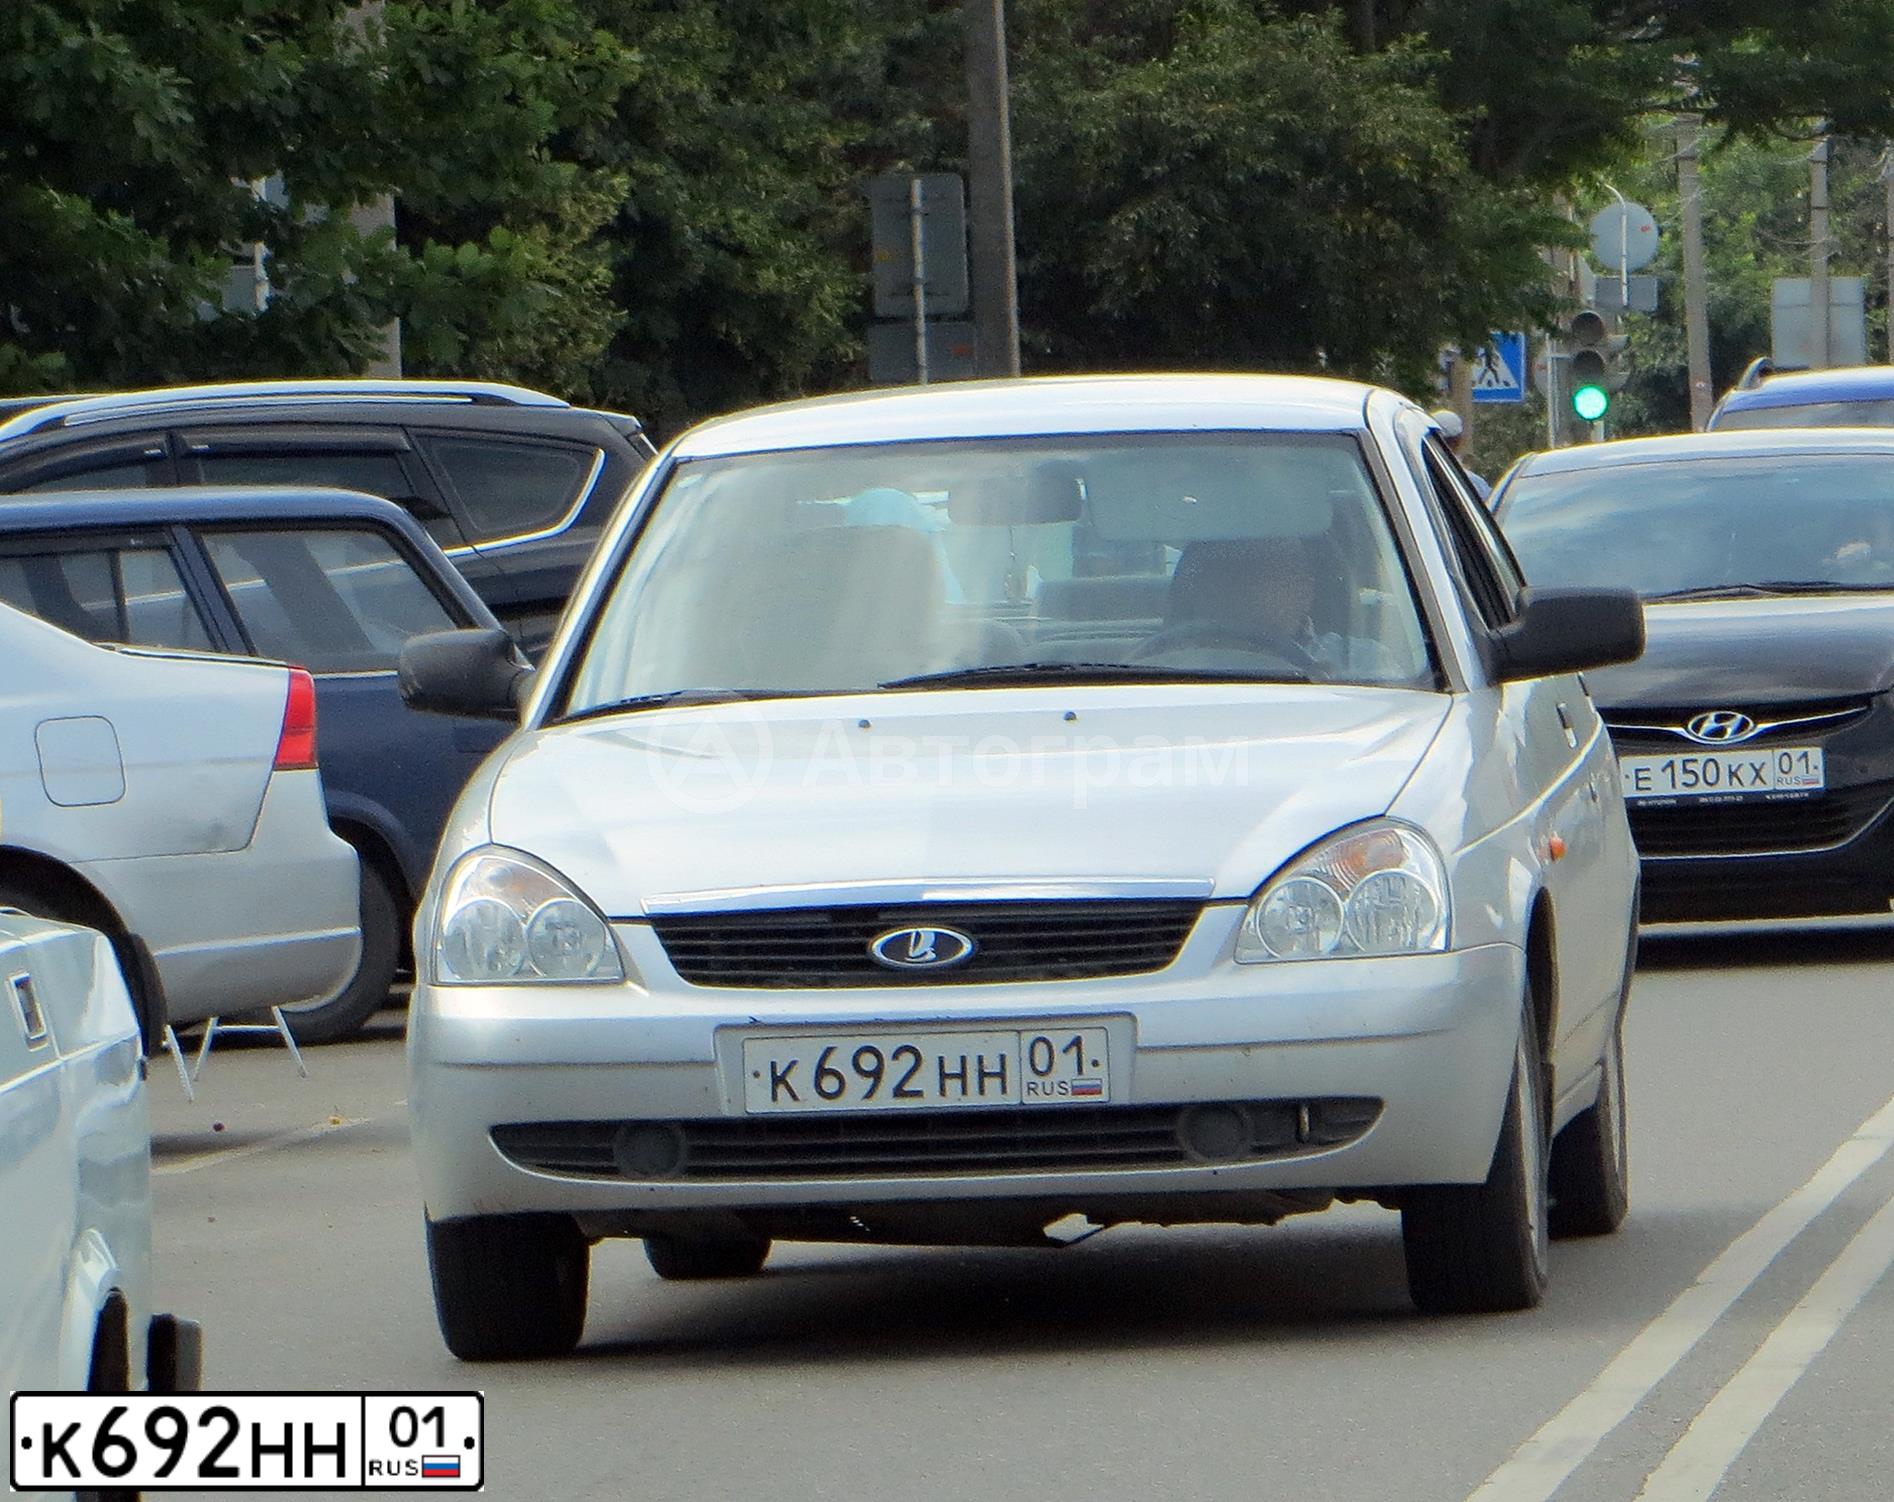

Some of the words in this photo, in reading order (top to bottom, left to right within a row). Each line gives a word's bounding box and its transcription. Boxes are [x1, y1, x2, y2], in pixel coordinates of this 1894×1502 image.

[1778, 751, 1811, 775] 01
[1777, 775, 1801, 786] RUS
[769, 1044, 1008, 1102] К692НН
[1028, 1035, 1085, 1077] 01
[1026, 1080, 1070, 1097] RUS
